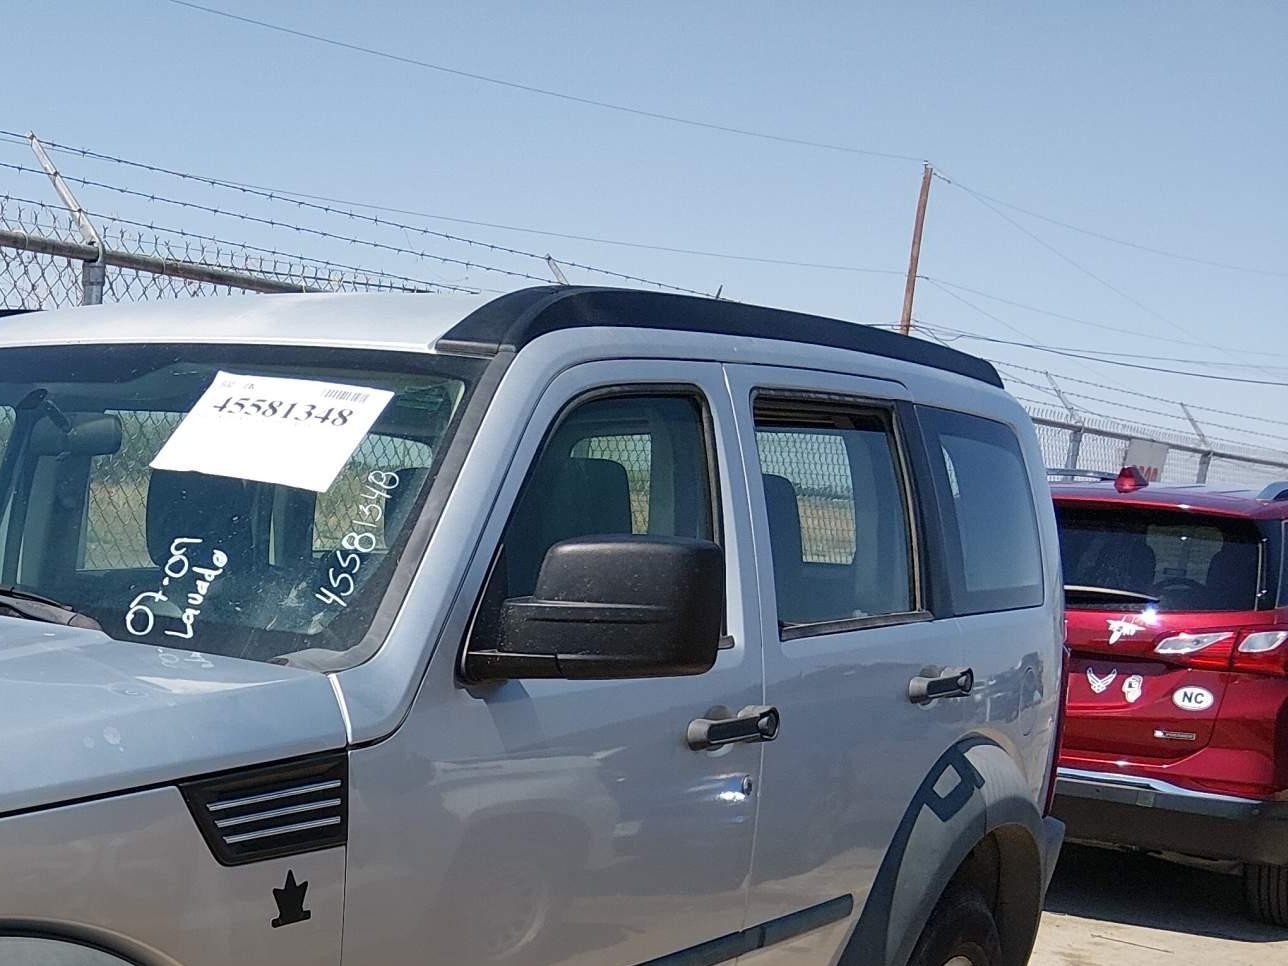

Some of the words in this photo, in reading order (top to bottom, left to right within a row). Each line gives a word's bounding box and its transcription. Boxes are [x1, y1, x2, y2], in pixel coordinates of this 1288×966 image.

[213, 396, 354, 427] 45581348
[315, 470, 400, 607] 45581348
[125, 537, 204, 636] 07-09
[1181, 690, 1205, 705] NC
